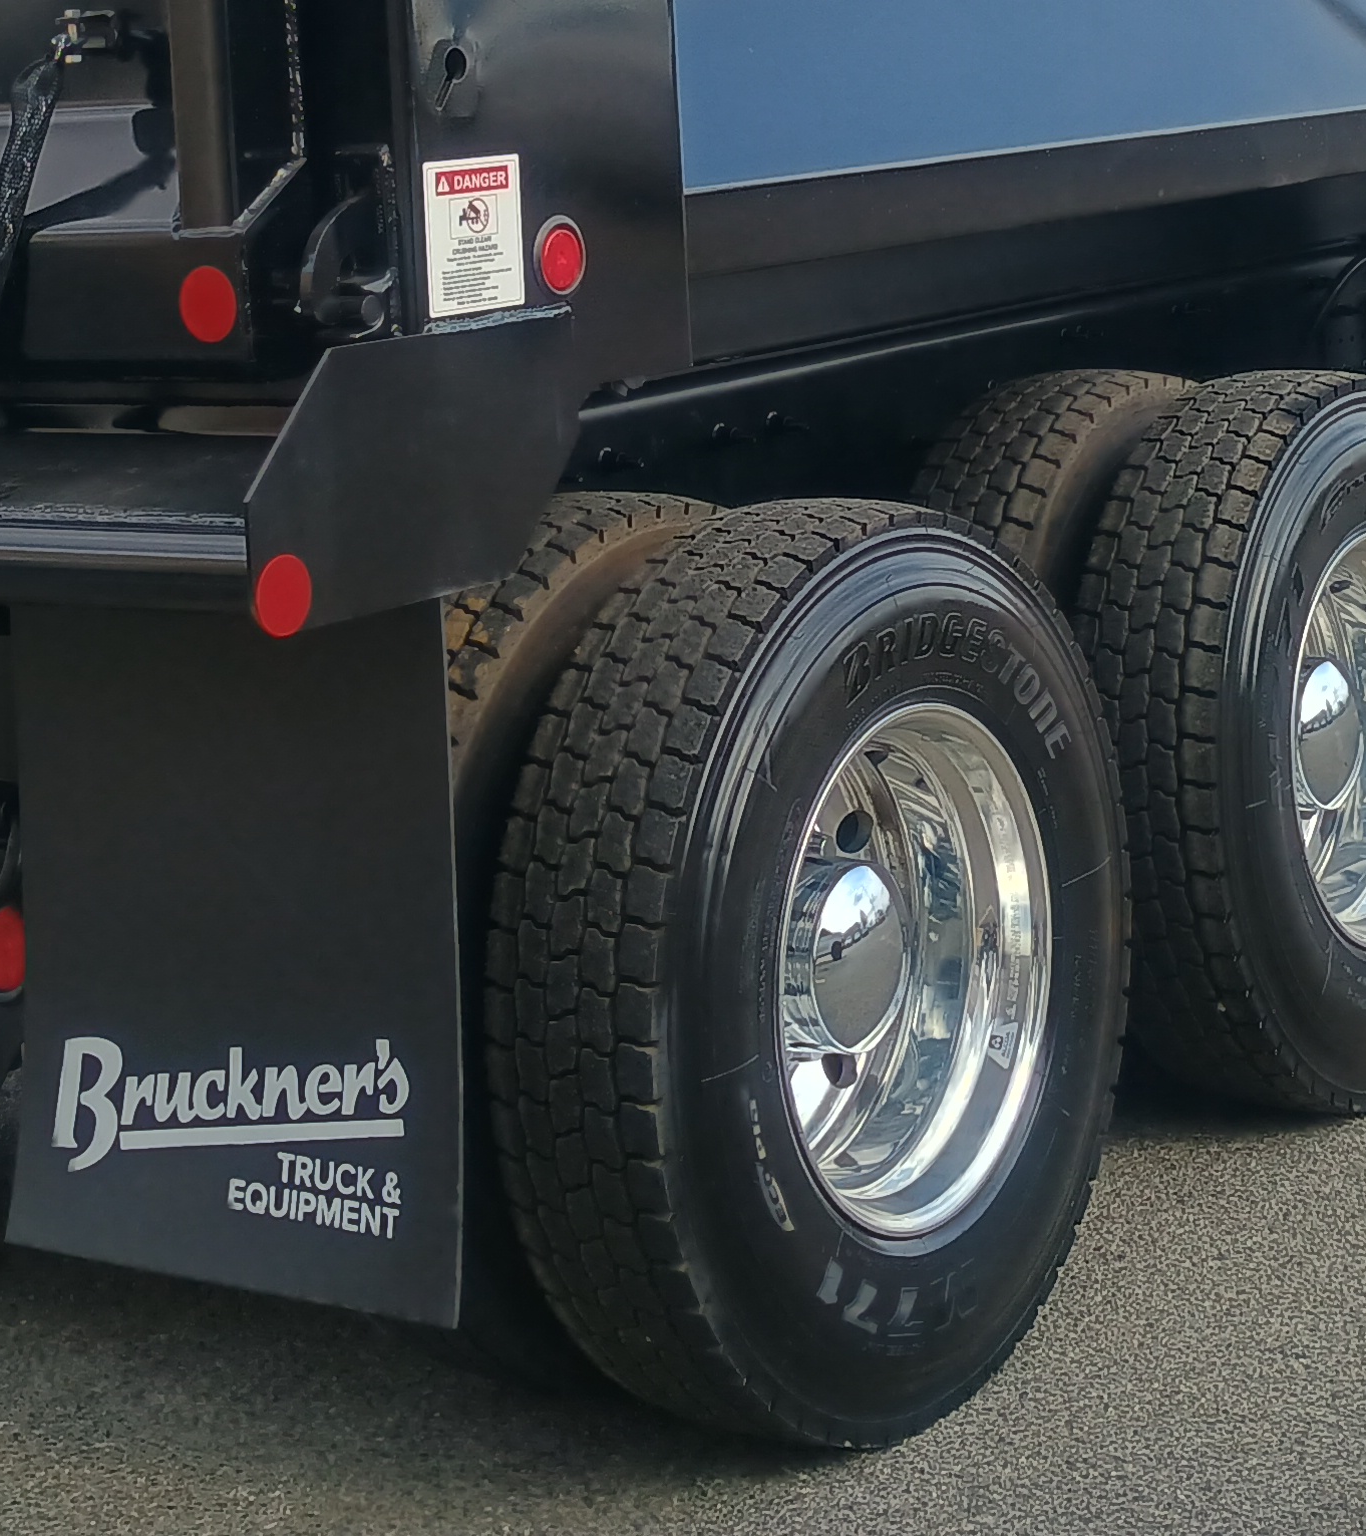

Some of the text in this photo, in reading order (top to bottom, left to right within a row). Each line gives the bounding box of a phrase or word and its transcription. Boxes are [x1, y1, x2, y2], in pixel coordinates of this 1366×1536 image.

[453, 170, 507, 191] DANGER
[843, 611, 1072, 759] BRIDGESTONE
[51, 1036, 410, 1172] Bruckner's
[227, 1177, 400, 1239] EQUIPMENT
[276, 1151, 402, 1205] TRUCK &
